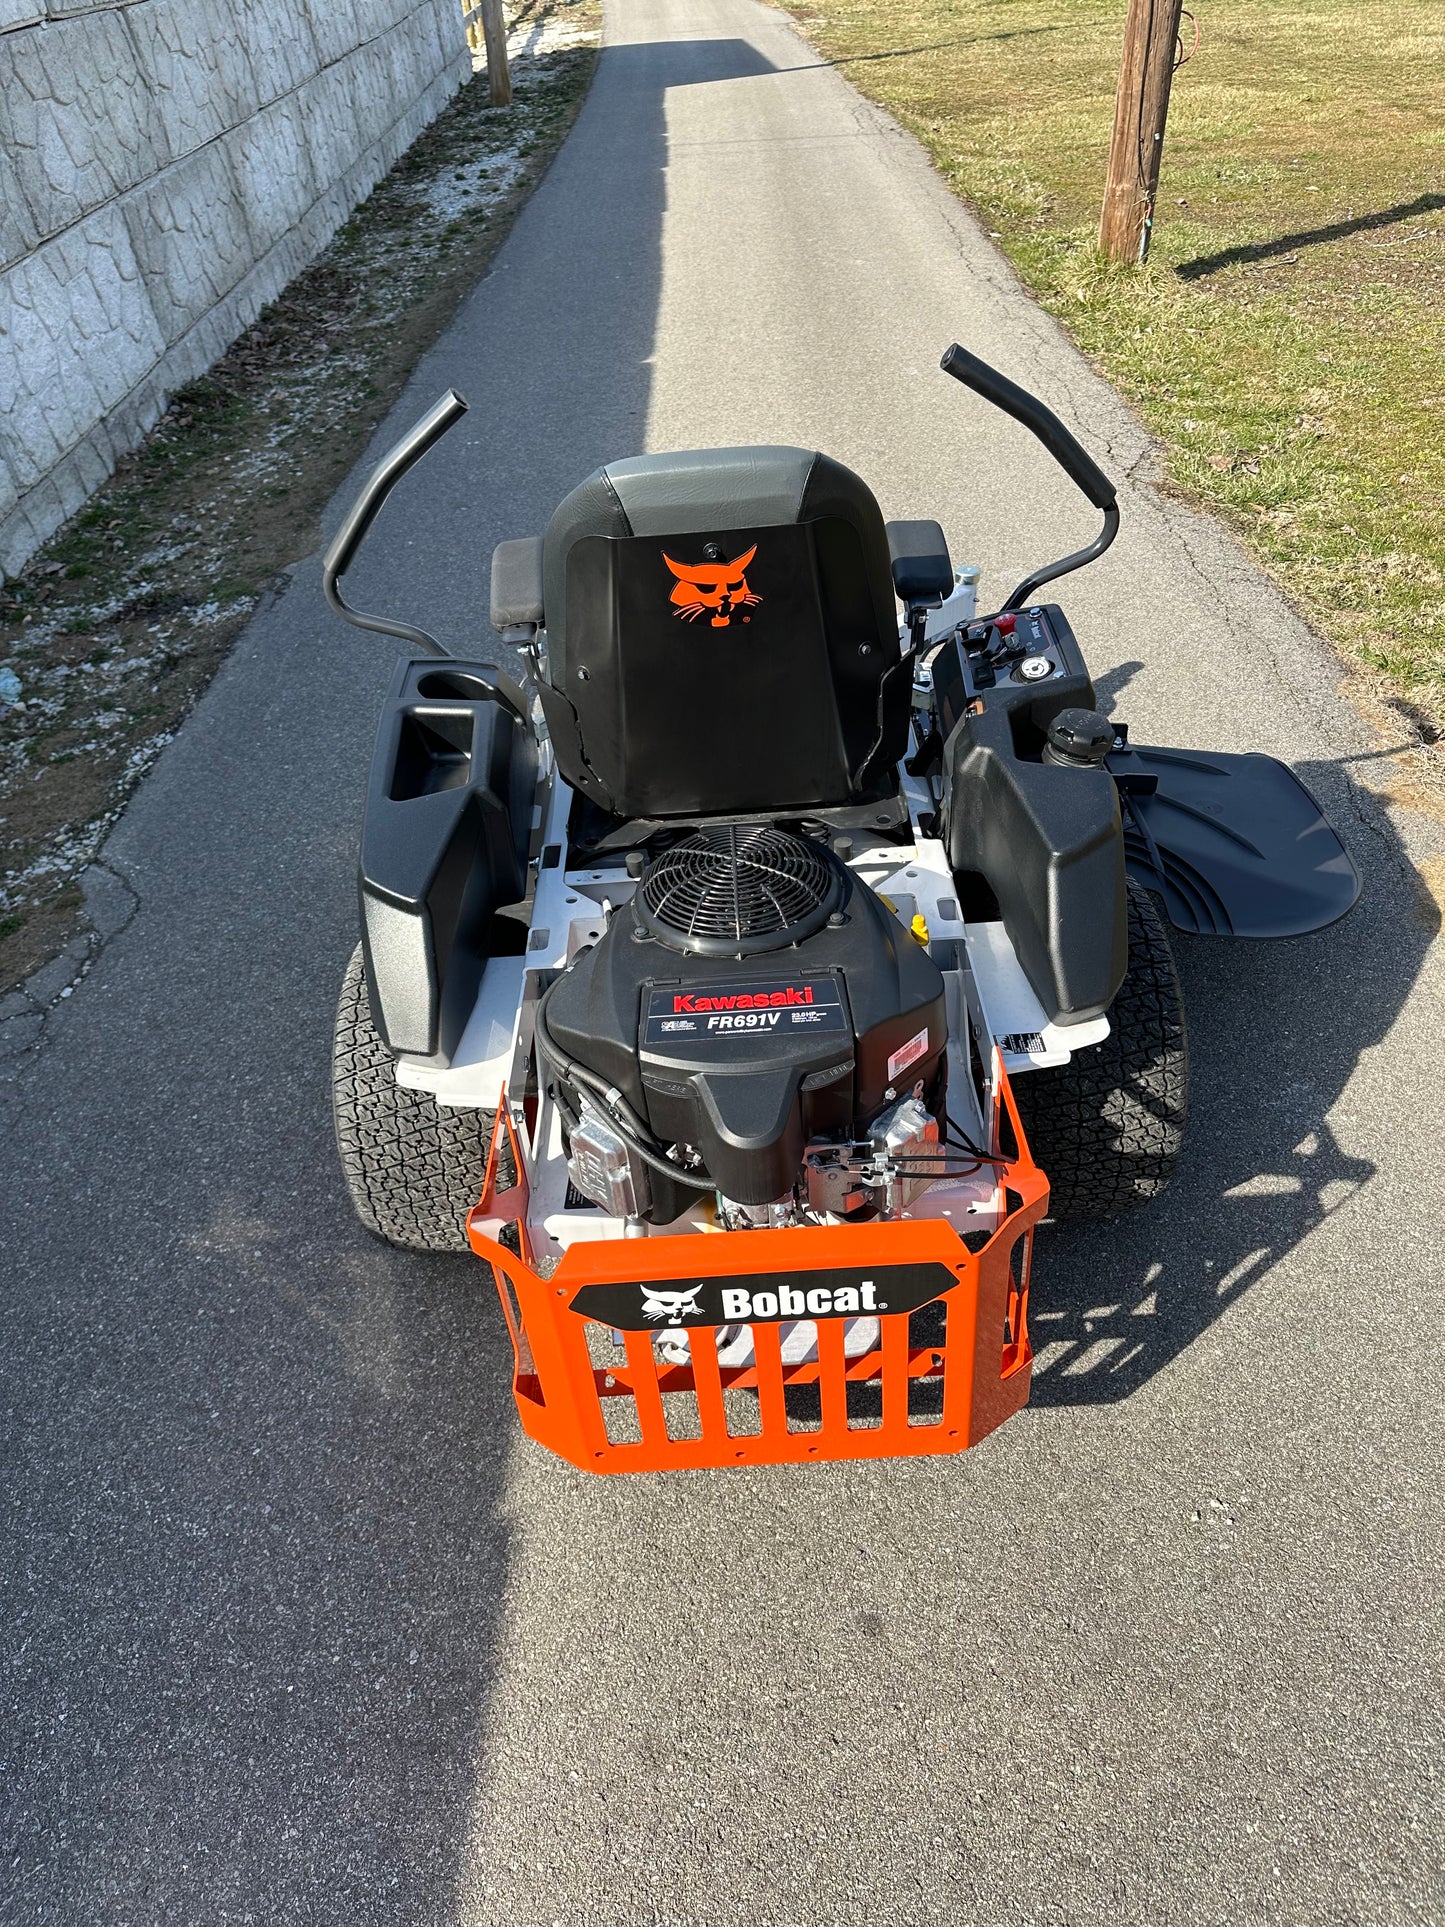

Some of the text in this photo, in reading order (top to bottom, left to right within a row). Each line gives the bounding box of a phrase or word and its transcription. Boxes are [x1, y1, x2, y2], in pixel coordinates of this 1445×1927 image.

[673, 986, 814, 1013] Kawasaki
[707, 1012, 781, 1029] FR691V
[721, 1281, 877, 1320] Bobcat
